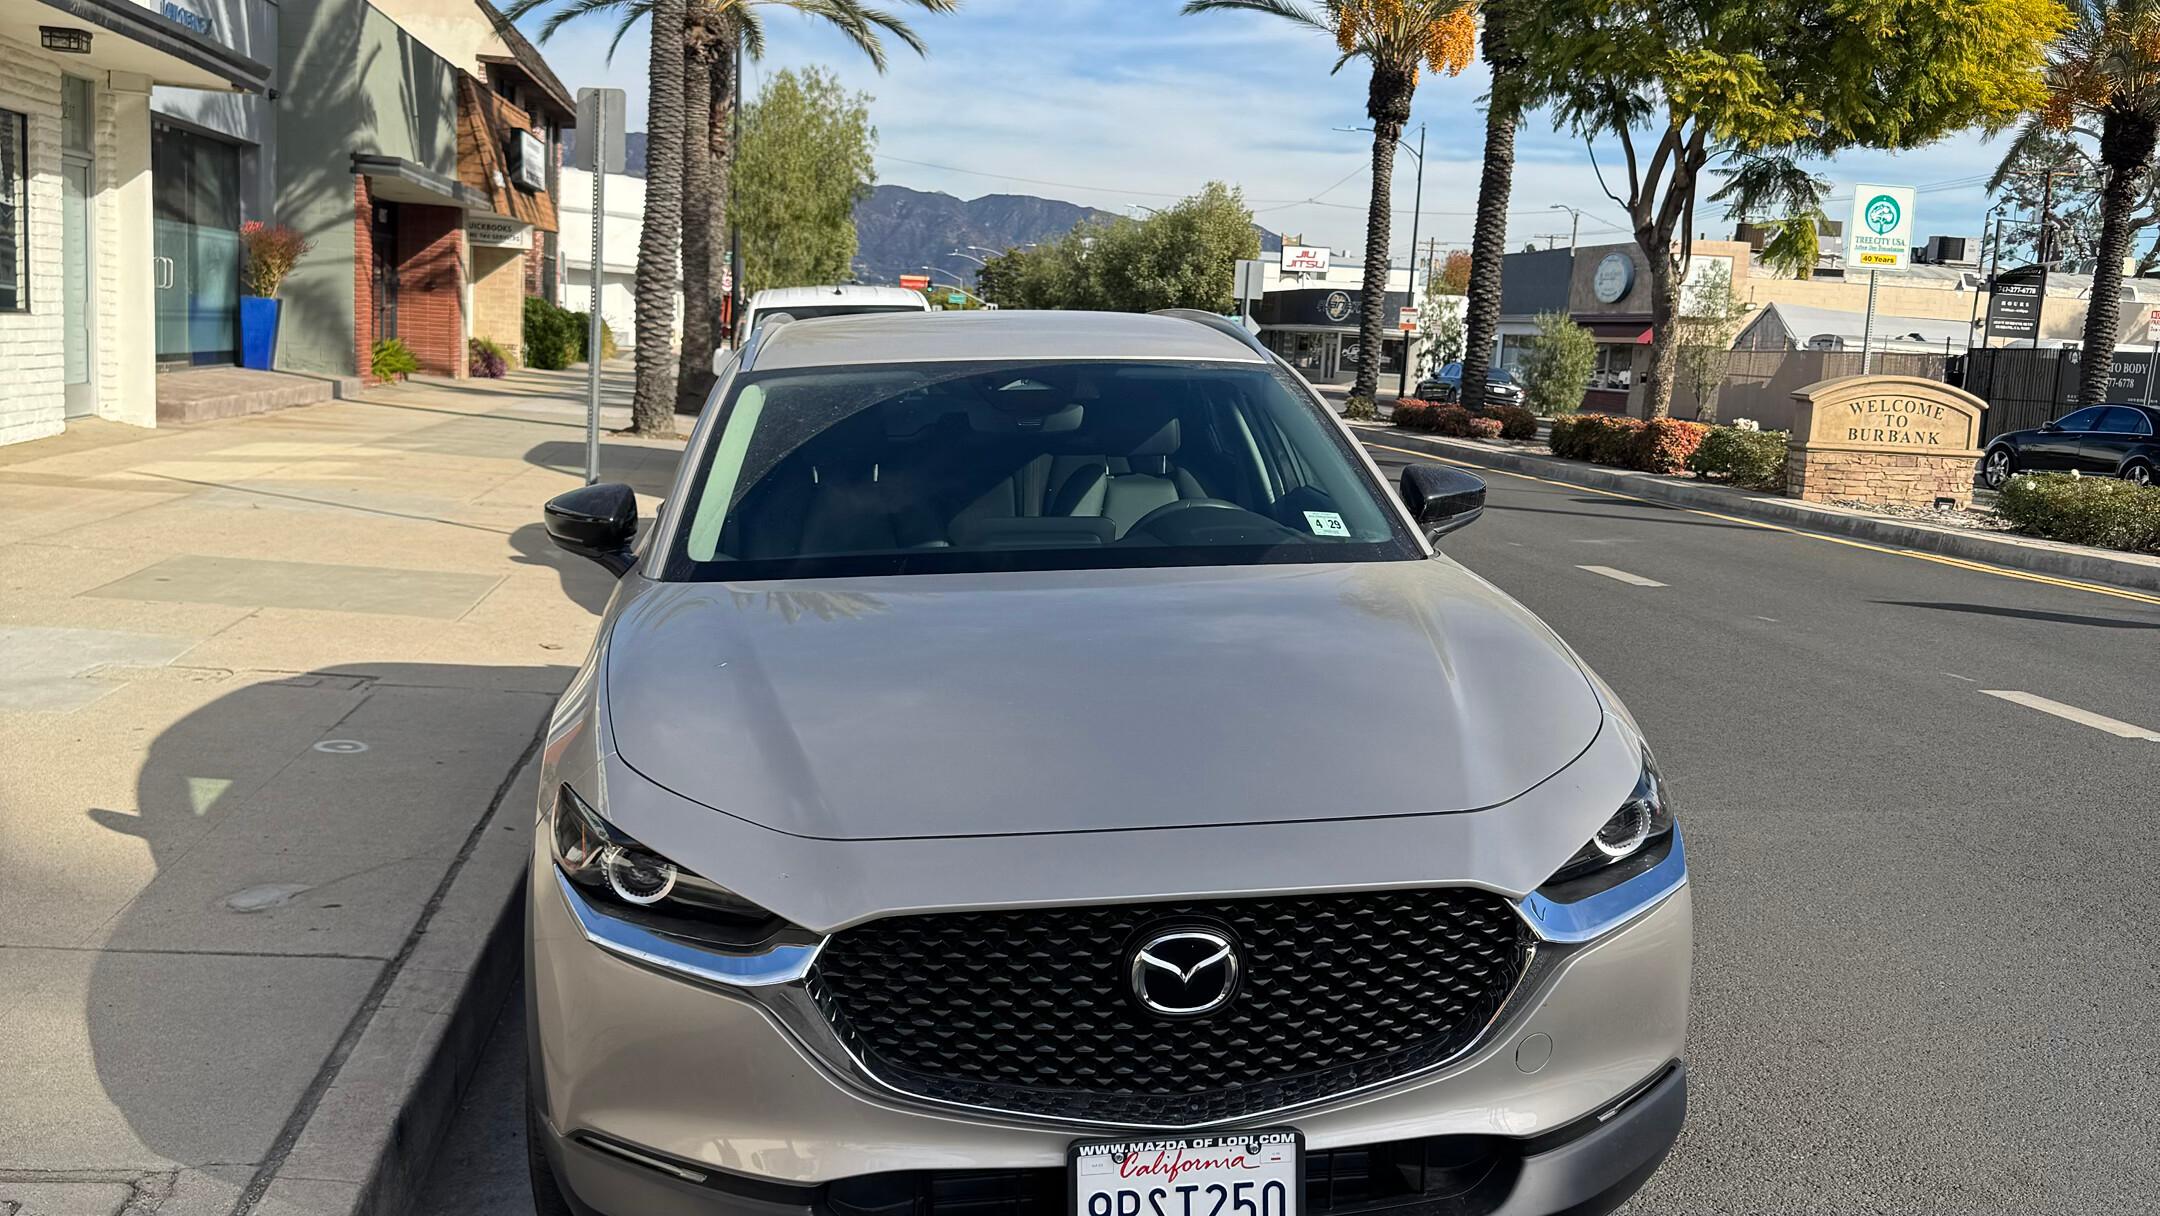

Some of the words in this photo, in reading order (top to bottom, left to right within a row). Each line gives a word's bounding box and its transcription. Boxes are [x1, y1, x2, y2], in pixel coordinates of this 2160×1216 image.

[469, 222, 512, 233] UICKBOOKS
[1855, 236, 1873, 244] TREE
[1874, 237, 1891, 245] CITY
[1892, 238, 1906, 246] USA
[1296, 250, 1316, 259] JIU
[1862, 255, 1873, 263] 40
[1874, 256, 1895, 264] Years
[1286, 260, 1325, 268] JITSU
[2123, 363, 2149, 374] BODY
[2107, 377, 2135, 388] 77-6778
[1849, 399, 1945, 421] WELCOME
[1884, 413, 1908, 428] TO
[1848, 427, 1940, 445] BURBANK
[1316, 519, 1323, 528] 4
[1327, 519, 1341, 529] 29
[1079, 1140, 1187, 1156] WWW.MAZDA
[1192, 1138, 1213, 1148] OF
[1218, 1133, 1295, 1147] LODI.COM
[1119, 1150, 1261, 1184] California
